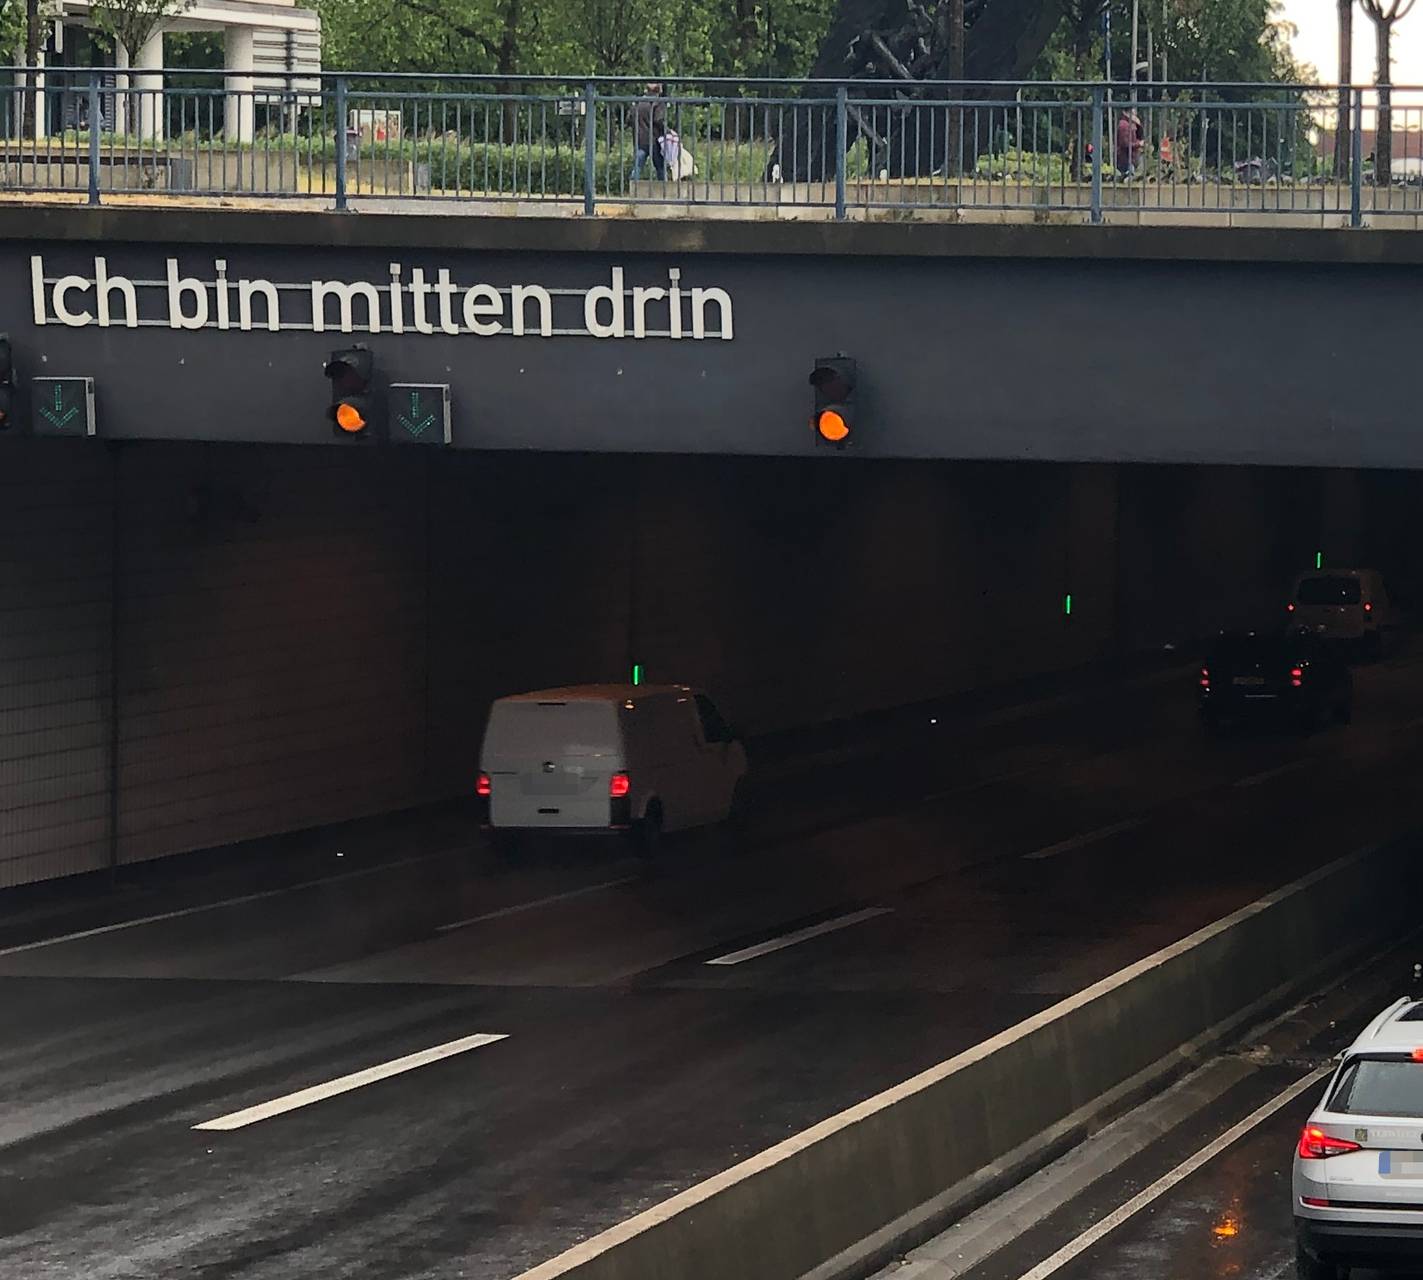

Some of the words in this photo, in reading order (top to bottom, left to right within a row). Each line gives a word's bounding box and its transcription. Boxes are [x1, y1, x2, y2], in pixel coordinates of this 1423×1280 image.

[30, 255, 138, 329] Ich
[167, 257, 280, 332] bin
[311, 262, 553, 337] mitten
[584, 266, 734, 340] drin
